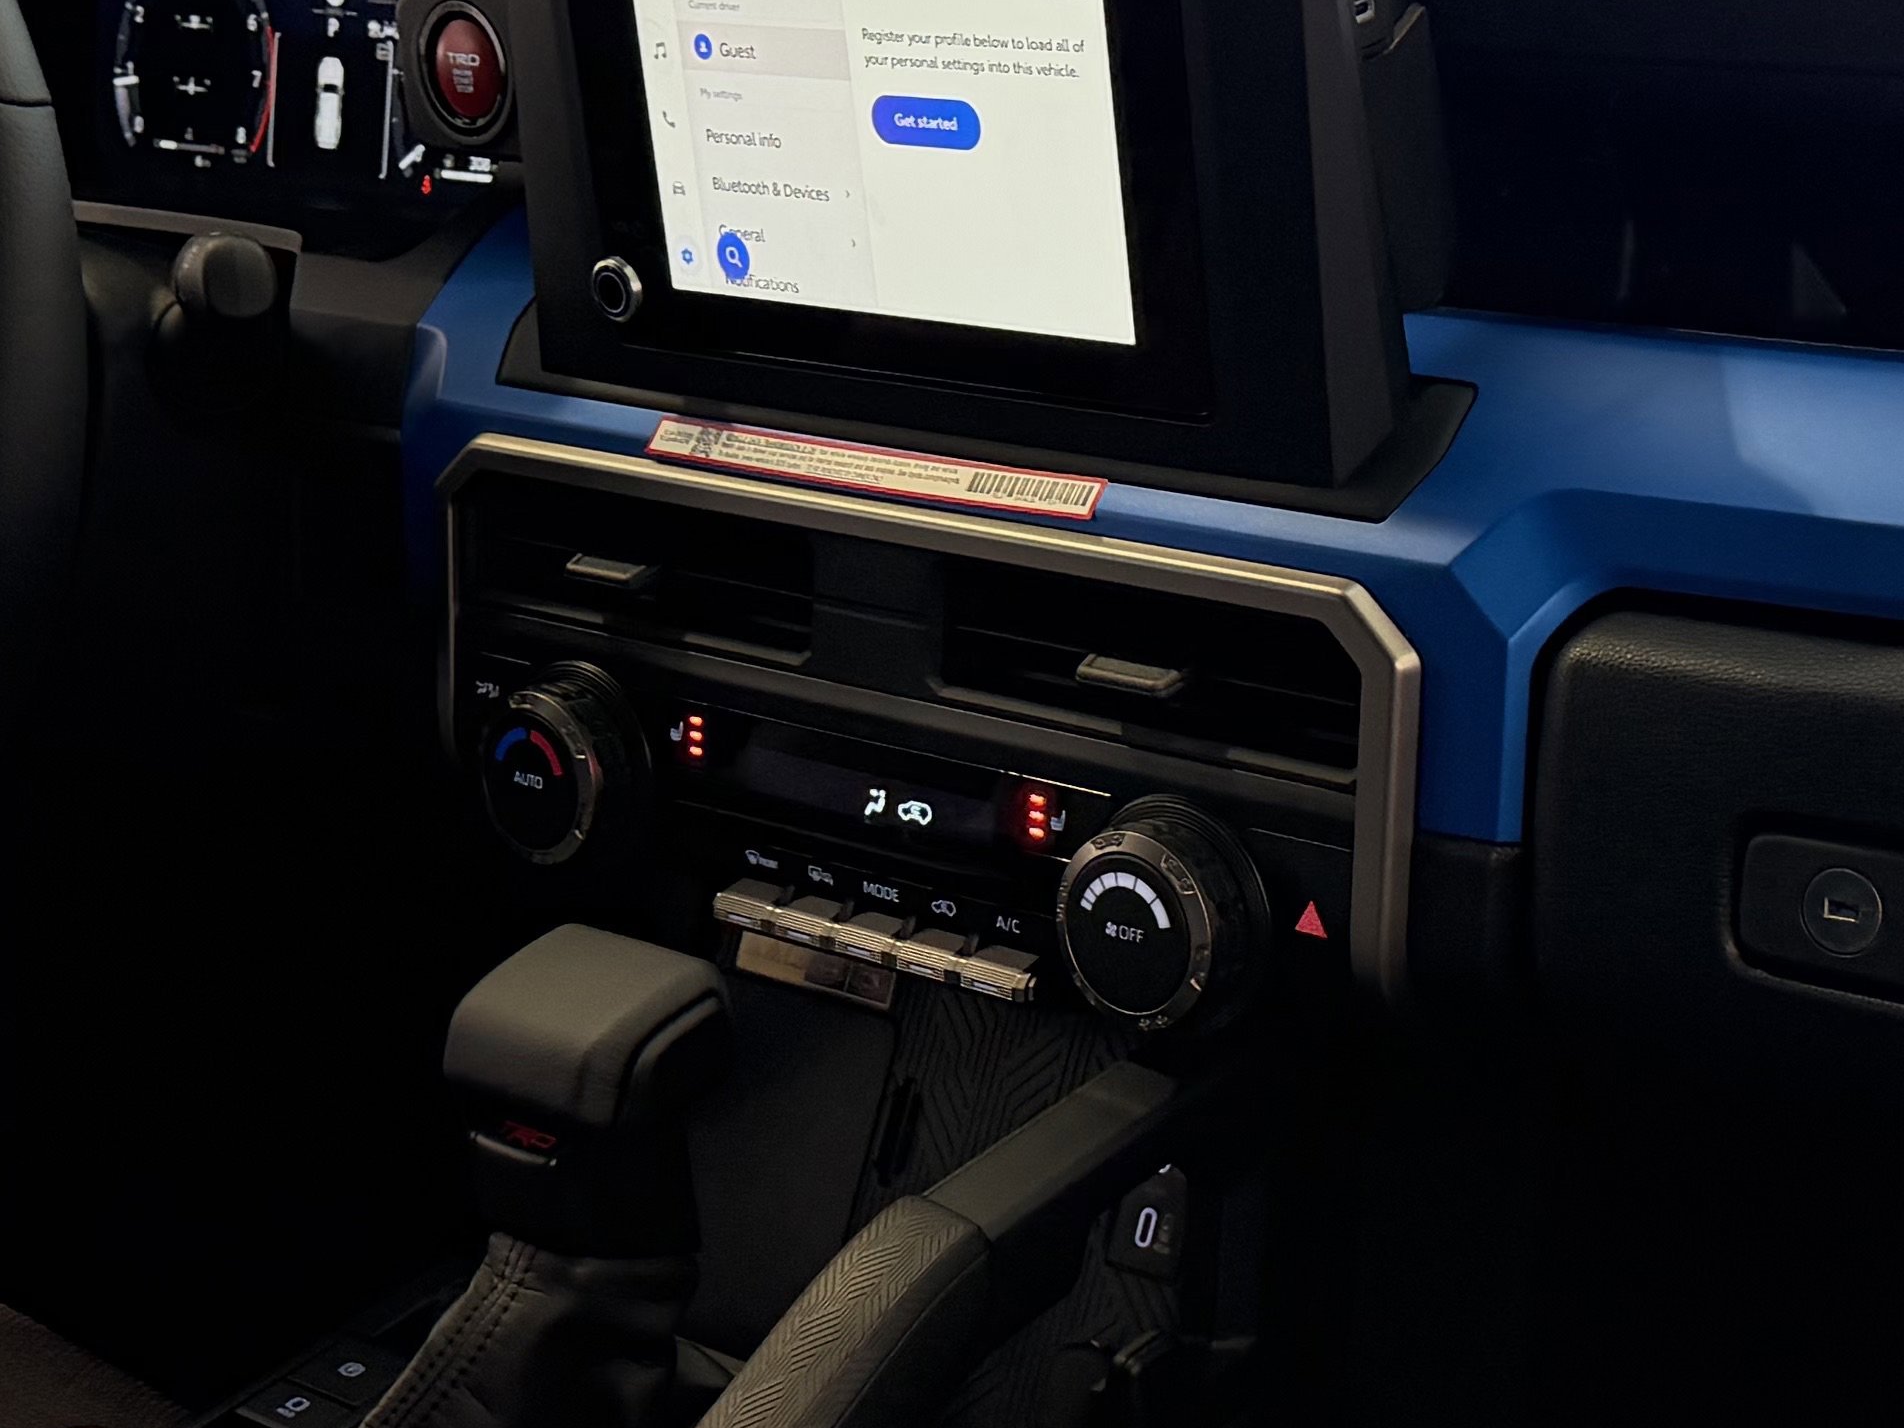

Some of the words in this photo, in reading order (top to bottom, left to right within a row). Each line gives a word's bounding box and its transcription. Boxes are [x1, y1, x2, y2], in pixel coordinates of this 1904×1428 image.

[134, 5, 145, 24] 2
[687, 0, 718, 12] Current
[718, 0, 741, 12] driver
[247, 13, 258, 32] 6
[327, 17, 340, 38] P
[719, 42, 757, 60] Guest
[861, 28, 905, 45] Register
[907, 33, 932, 47] your
[934, 33, 972, 49] profile
[972, 35, 1010, 50] below
[1011, 38, 1026, 50] to
[1026, 37, 1054, 52] load
[1055, 38, 1071, 53] all
[1072, 39, 1086, 53] of
[447, 51, 480, 68] TRD
[864, 55, 889, 69] your
[890, 55, 940, 70] personal
[941, 58, 986, 76] settings
[987, 59, 1011, 75] into
[1012, 61, 1034, 77] this
[1034, 63, 1081, 79] vehicle.
[251, 70, 262, 89] 7
[894, 112, 917, 129] Get
[917, 115, 959, 133] started
[705, 128, 757, 148] Personal
[758, 132, 782, 149] info
[712, 176, 770, 196] Bluetooth
[771, 182, 781, 197] &
[783, 183, 831, 202] Devices
[718, 224, 766, 243] Gneral
[513, 769, 544, 791] AUTO
[863, 880, 900, 903] MODE
[995, 913, 1021, 935] A/C
[1118, 924, 1145, 945] OFF
[504, 1119, 558, 1150] TRD
